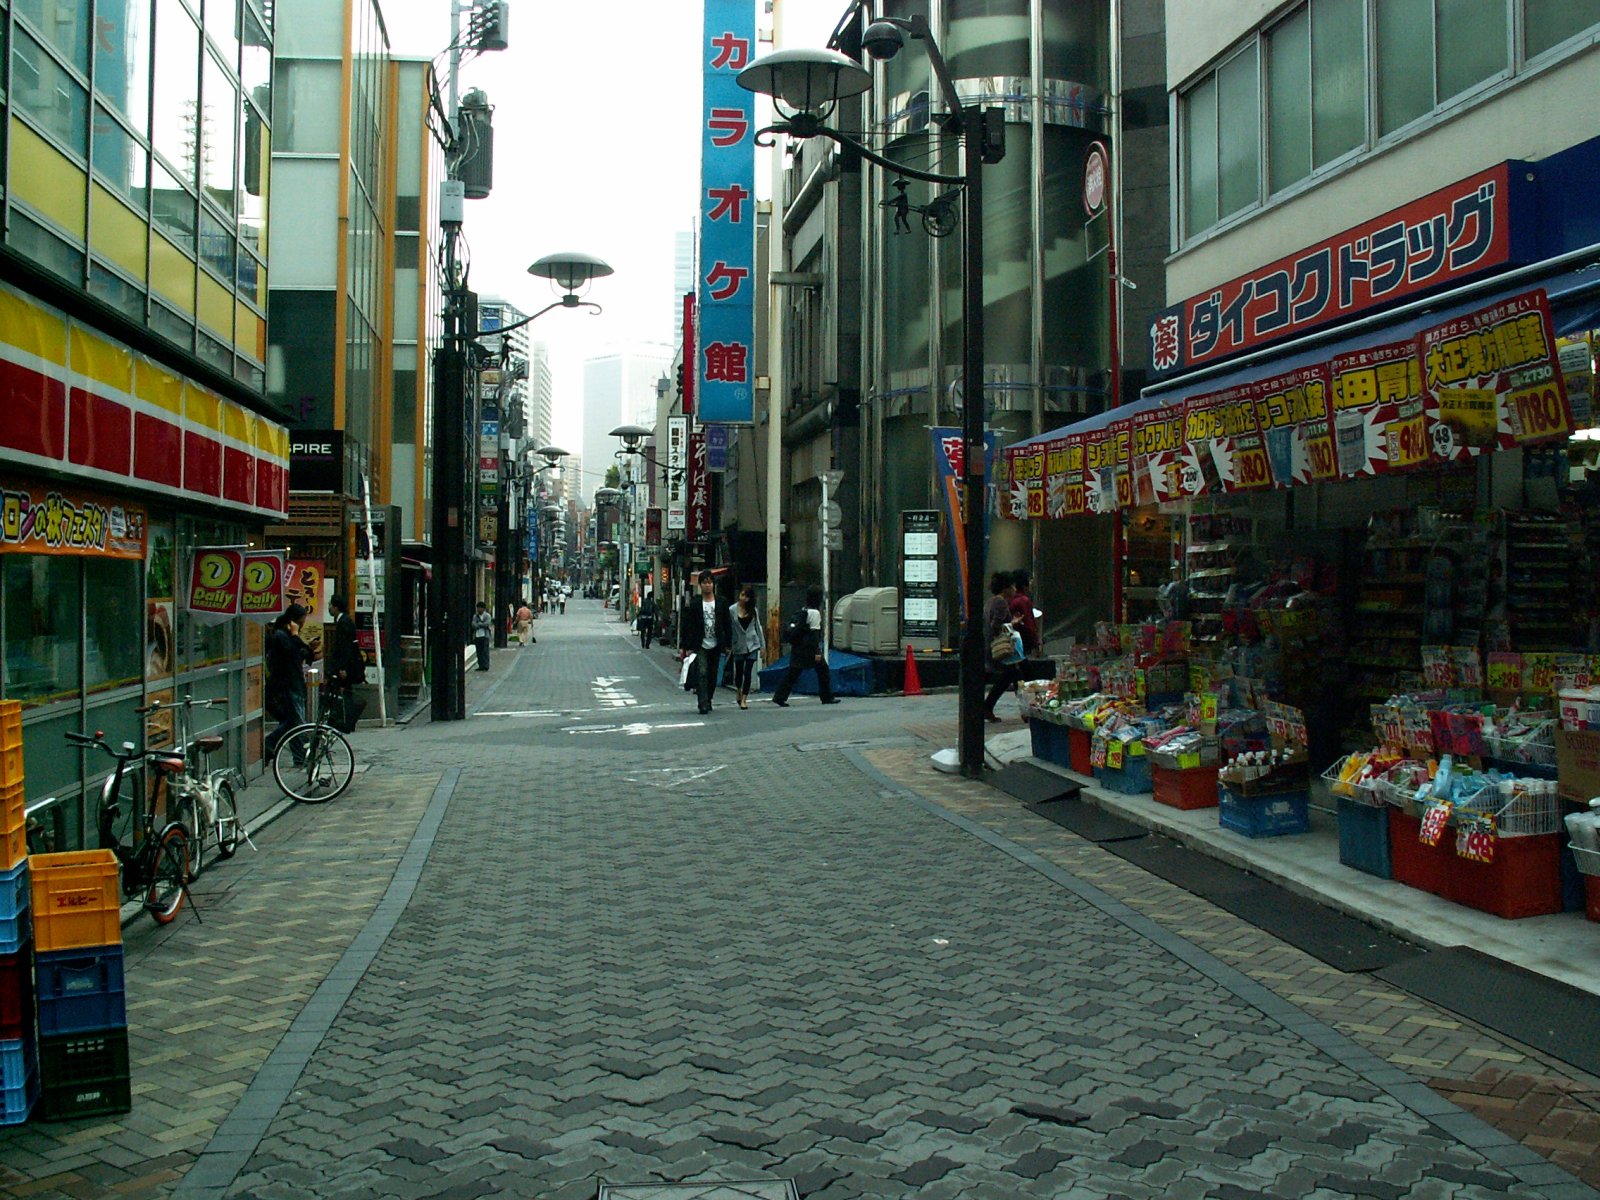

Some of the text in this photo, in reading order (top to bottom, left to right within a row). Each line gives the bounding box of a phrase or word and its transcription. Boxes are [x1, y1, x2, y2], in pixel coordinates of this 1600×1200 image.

[704, 31, 750, 384] カラオケ館
[1150, 180, 1496, 371] 薬 ダイコクドラッグ
[193, 587, 234, 608] Daily
[243, 591, 278, 608] Daily
